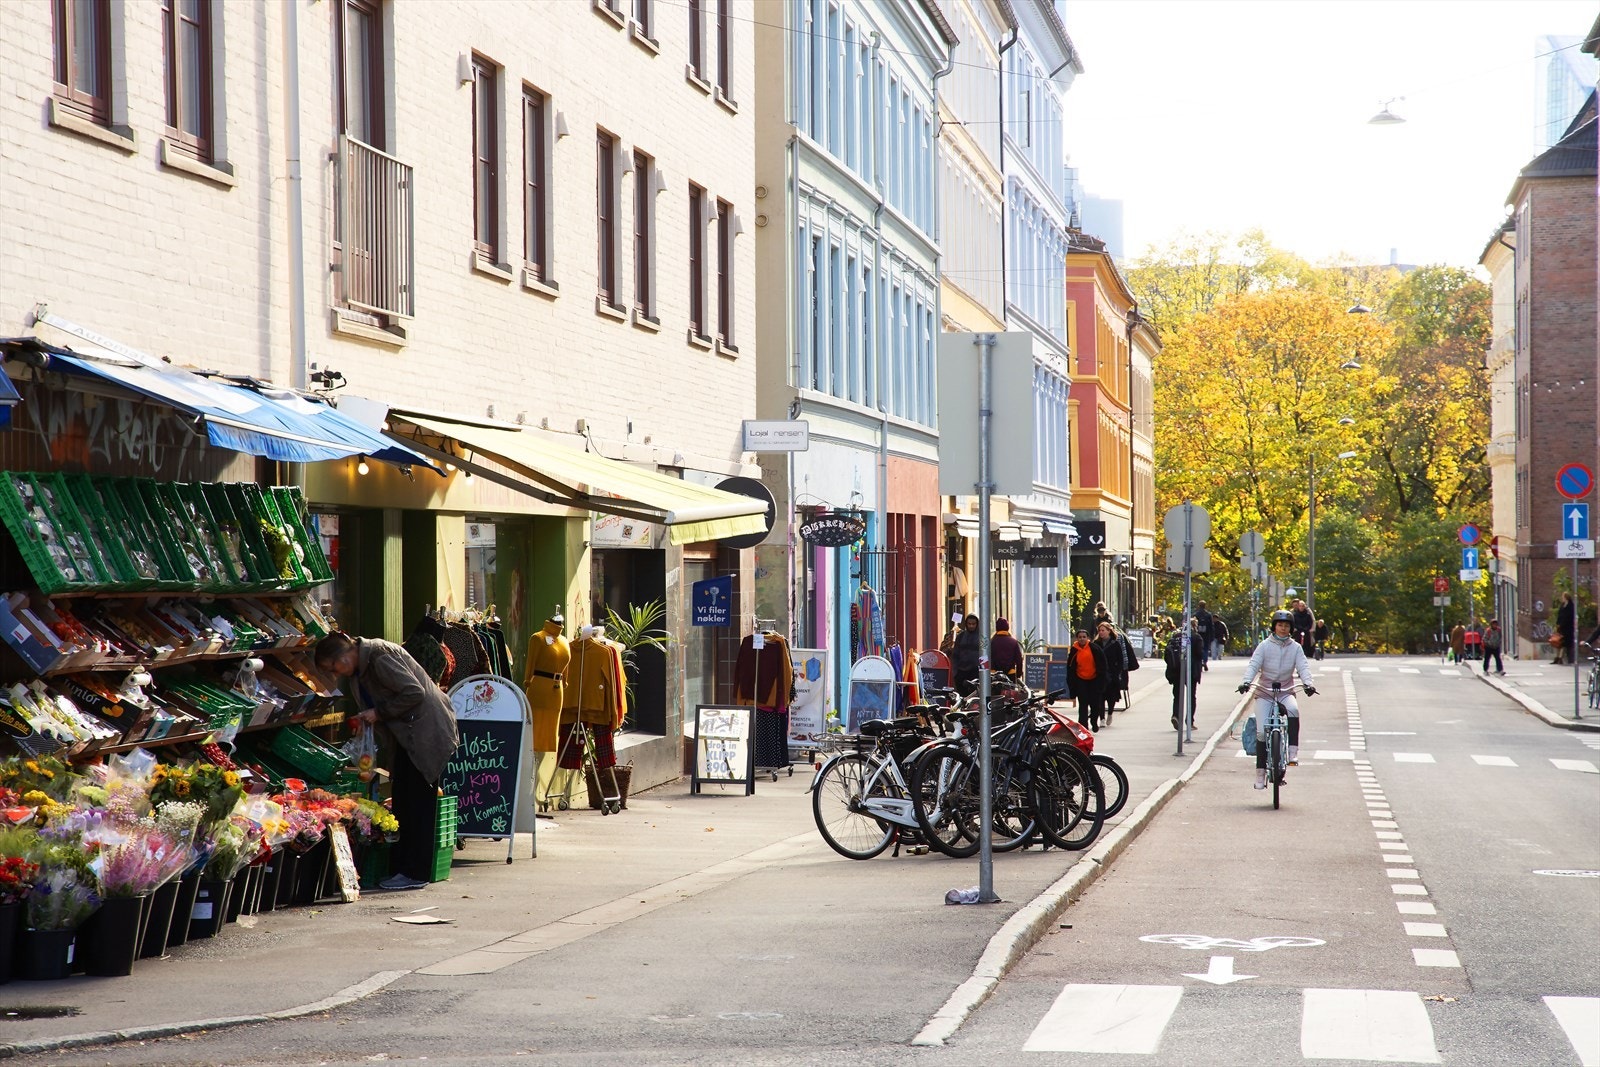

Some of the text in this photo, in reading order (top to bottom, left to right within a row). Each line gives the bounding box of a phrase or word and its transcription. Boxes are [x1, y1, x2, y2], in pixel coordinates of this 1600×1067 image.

[708, 606, 727, 614] filer
[697, 614, 726, 623] nøkler
[455, 731, 506, 758] Høst-
[729, 741, 737, 750] in
[706, 751, 736, 761] KLIPP
[470, 772, 501, 794] King
[457, 790, 484, 809] ouie
[457, 812, 470, 825] ar
